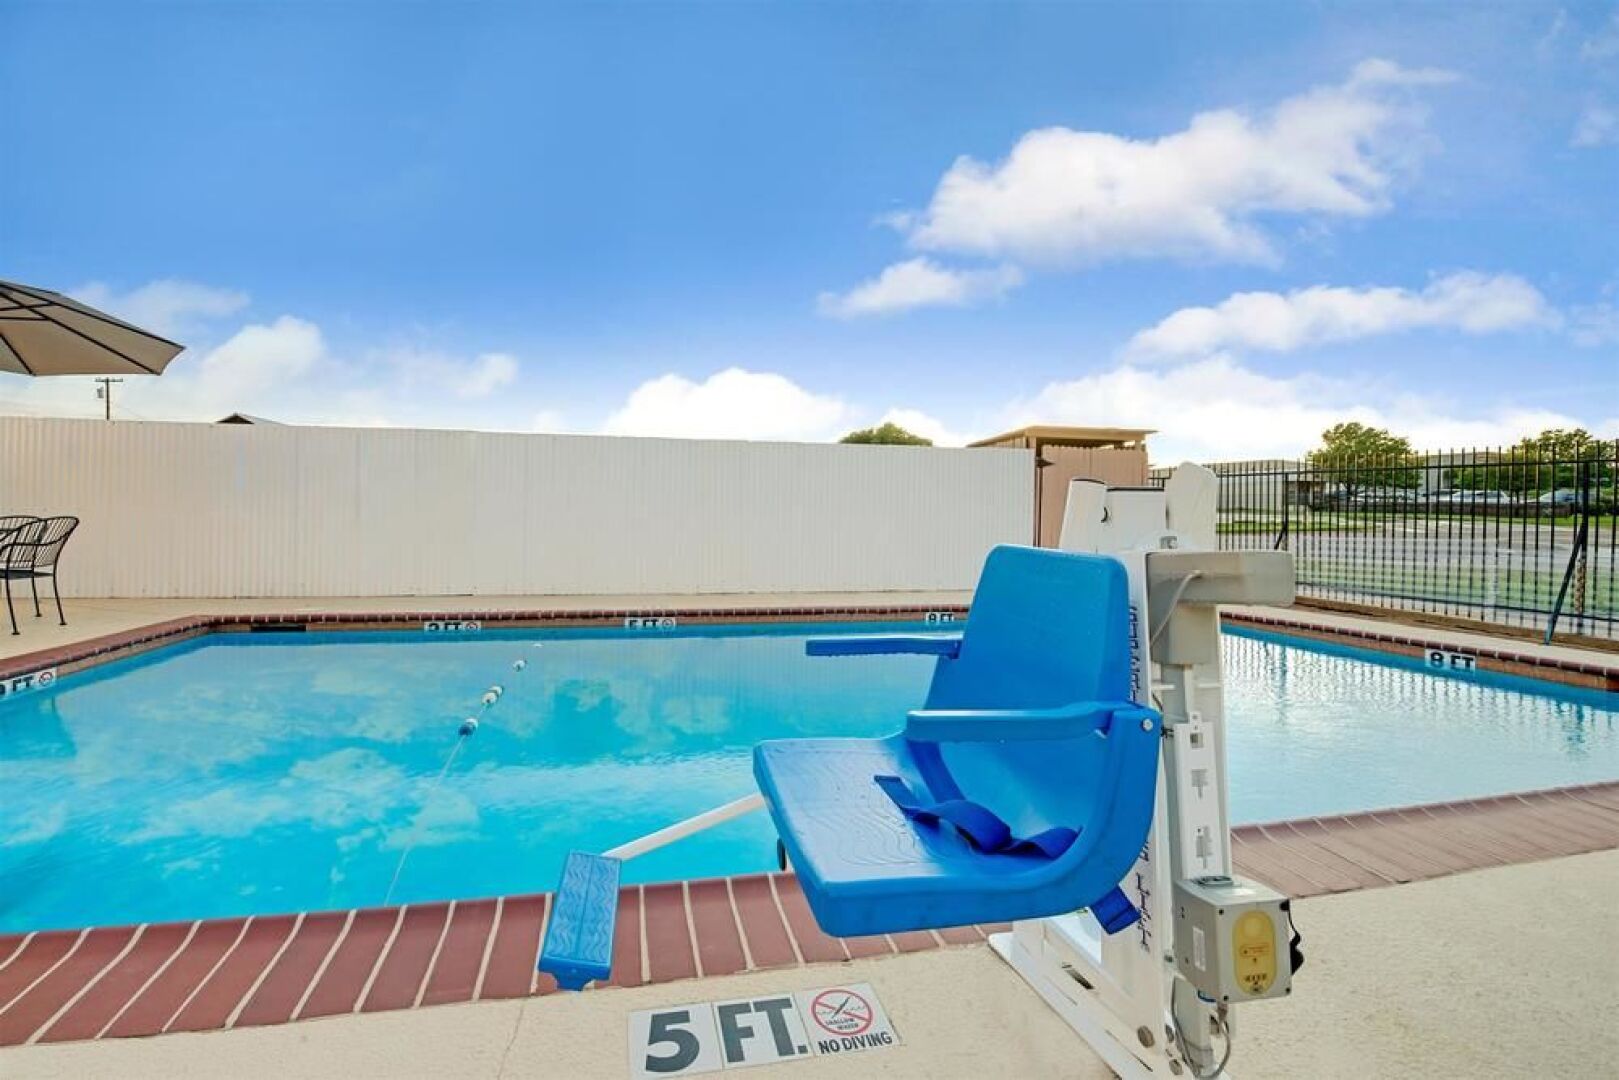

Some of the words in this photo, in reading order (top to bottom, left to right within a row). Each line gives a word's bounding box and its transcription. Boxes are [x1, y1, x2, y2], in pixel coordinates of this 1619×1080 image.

[1430, 651, 1444, 668] 8
[1450, 654, 1474, 669] FT
[645, 1009, 701, 1073] 5
[717, 997, 809, 1064] FT.
[818, 1038, 841, 1055] NO
[841, 1030, 893, 1051] DIVING
